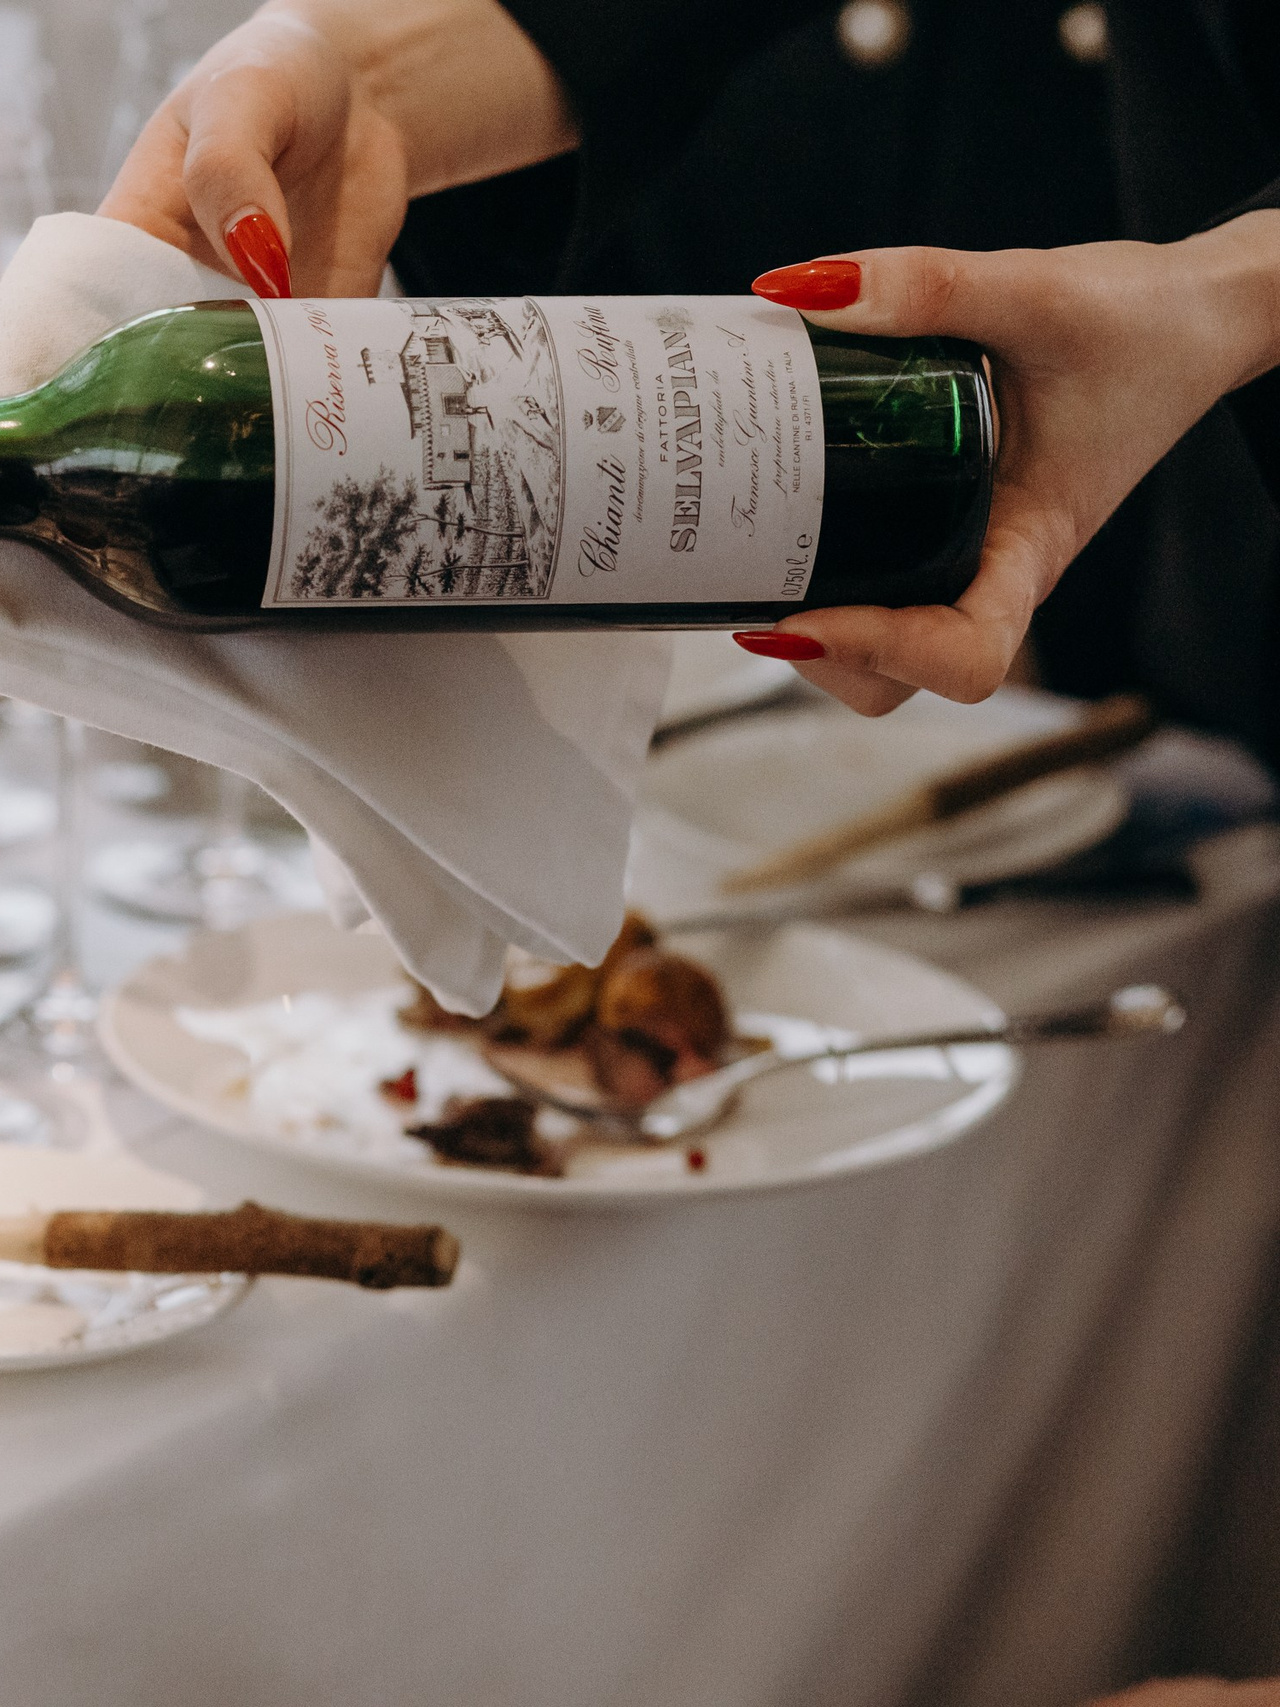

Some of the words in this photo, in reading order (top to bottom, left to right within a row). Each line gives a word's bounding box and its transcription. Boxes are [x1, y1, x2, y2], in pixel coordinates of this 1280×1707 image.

[573, 304, 621, 393] Rufina
[783, 350, 794, 374] ITALIA
[305, 344, 347, 456] Riserva
[636, 394, 647, 430] origine
[654, 374, 668, 462] FATTORIA
[732, 360, 768, 447] Giuntini
[788, 380, 798, 410] RUFINA
[791, 413, 800, 422] DI
[634, 432, 644, 442] di
[658, 308, 702, 552] SELVAPIAN
[792, 425, 800, 464] CANTINE
[730, 447, 759, 538] Francesco
[792, 466, 800, 492] NELLE
[578, 454, 625, 577] Chianti
